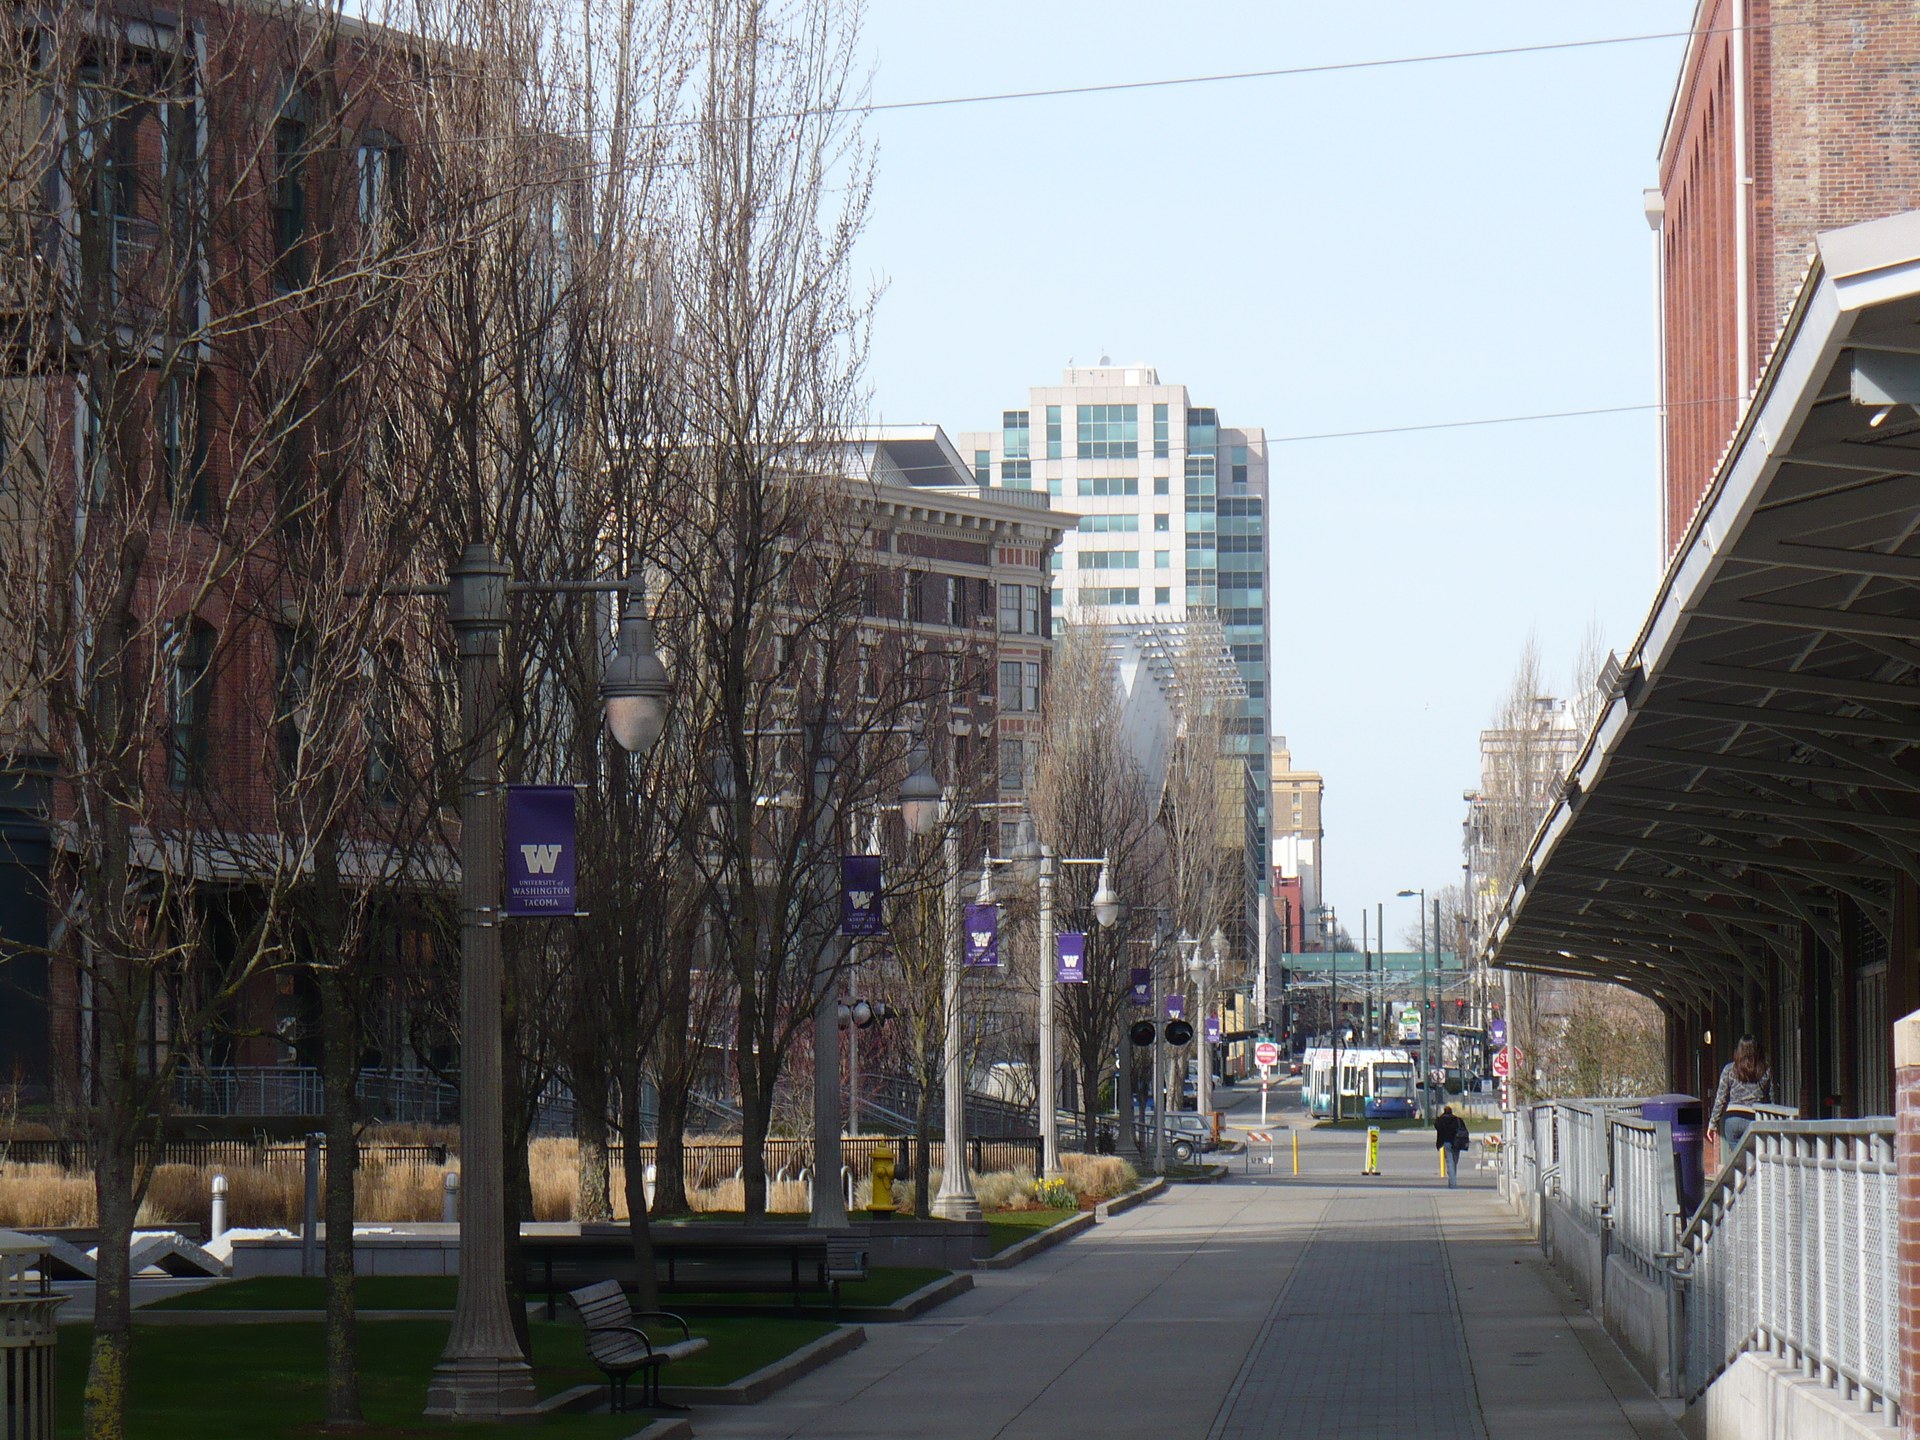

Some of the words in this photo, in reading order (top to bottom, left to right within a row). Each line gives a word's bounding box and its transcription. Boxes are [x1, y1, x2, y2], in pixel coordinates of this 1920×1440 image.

[520, 844, 562, 874] W
[512, 887, 570, 895] WASHINGTON
[524, 899, 559, 907] TACOMA
[848, 891, 874, 910] W
[971, 932, 992, 947] W
[1062, 954, 1079, 968] W
[1135, 985, 1147, 994] W
[1168, 1010, 1180, 1019] W
[1208, 1028, 1217, 1036] W
